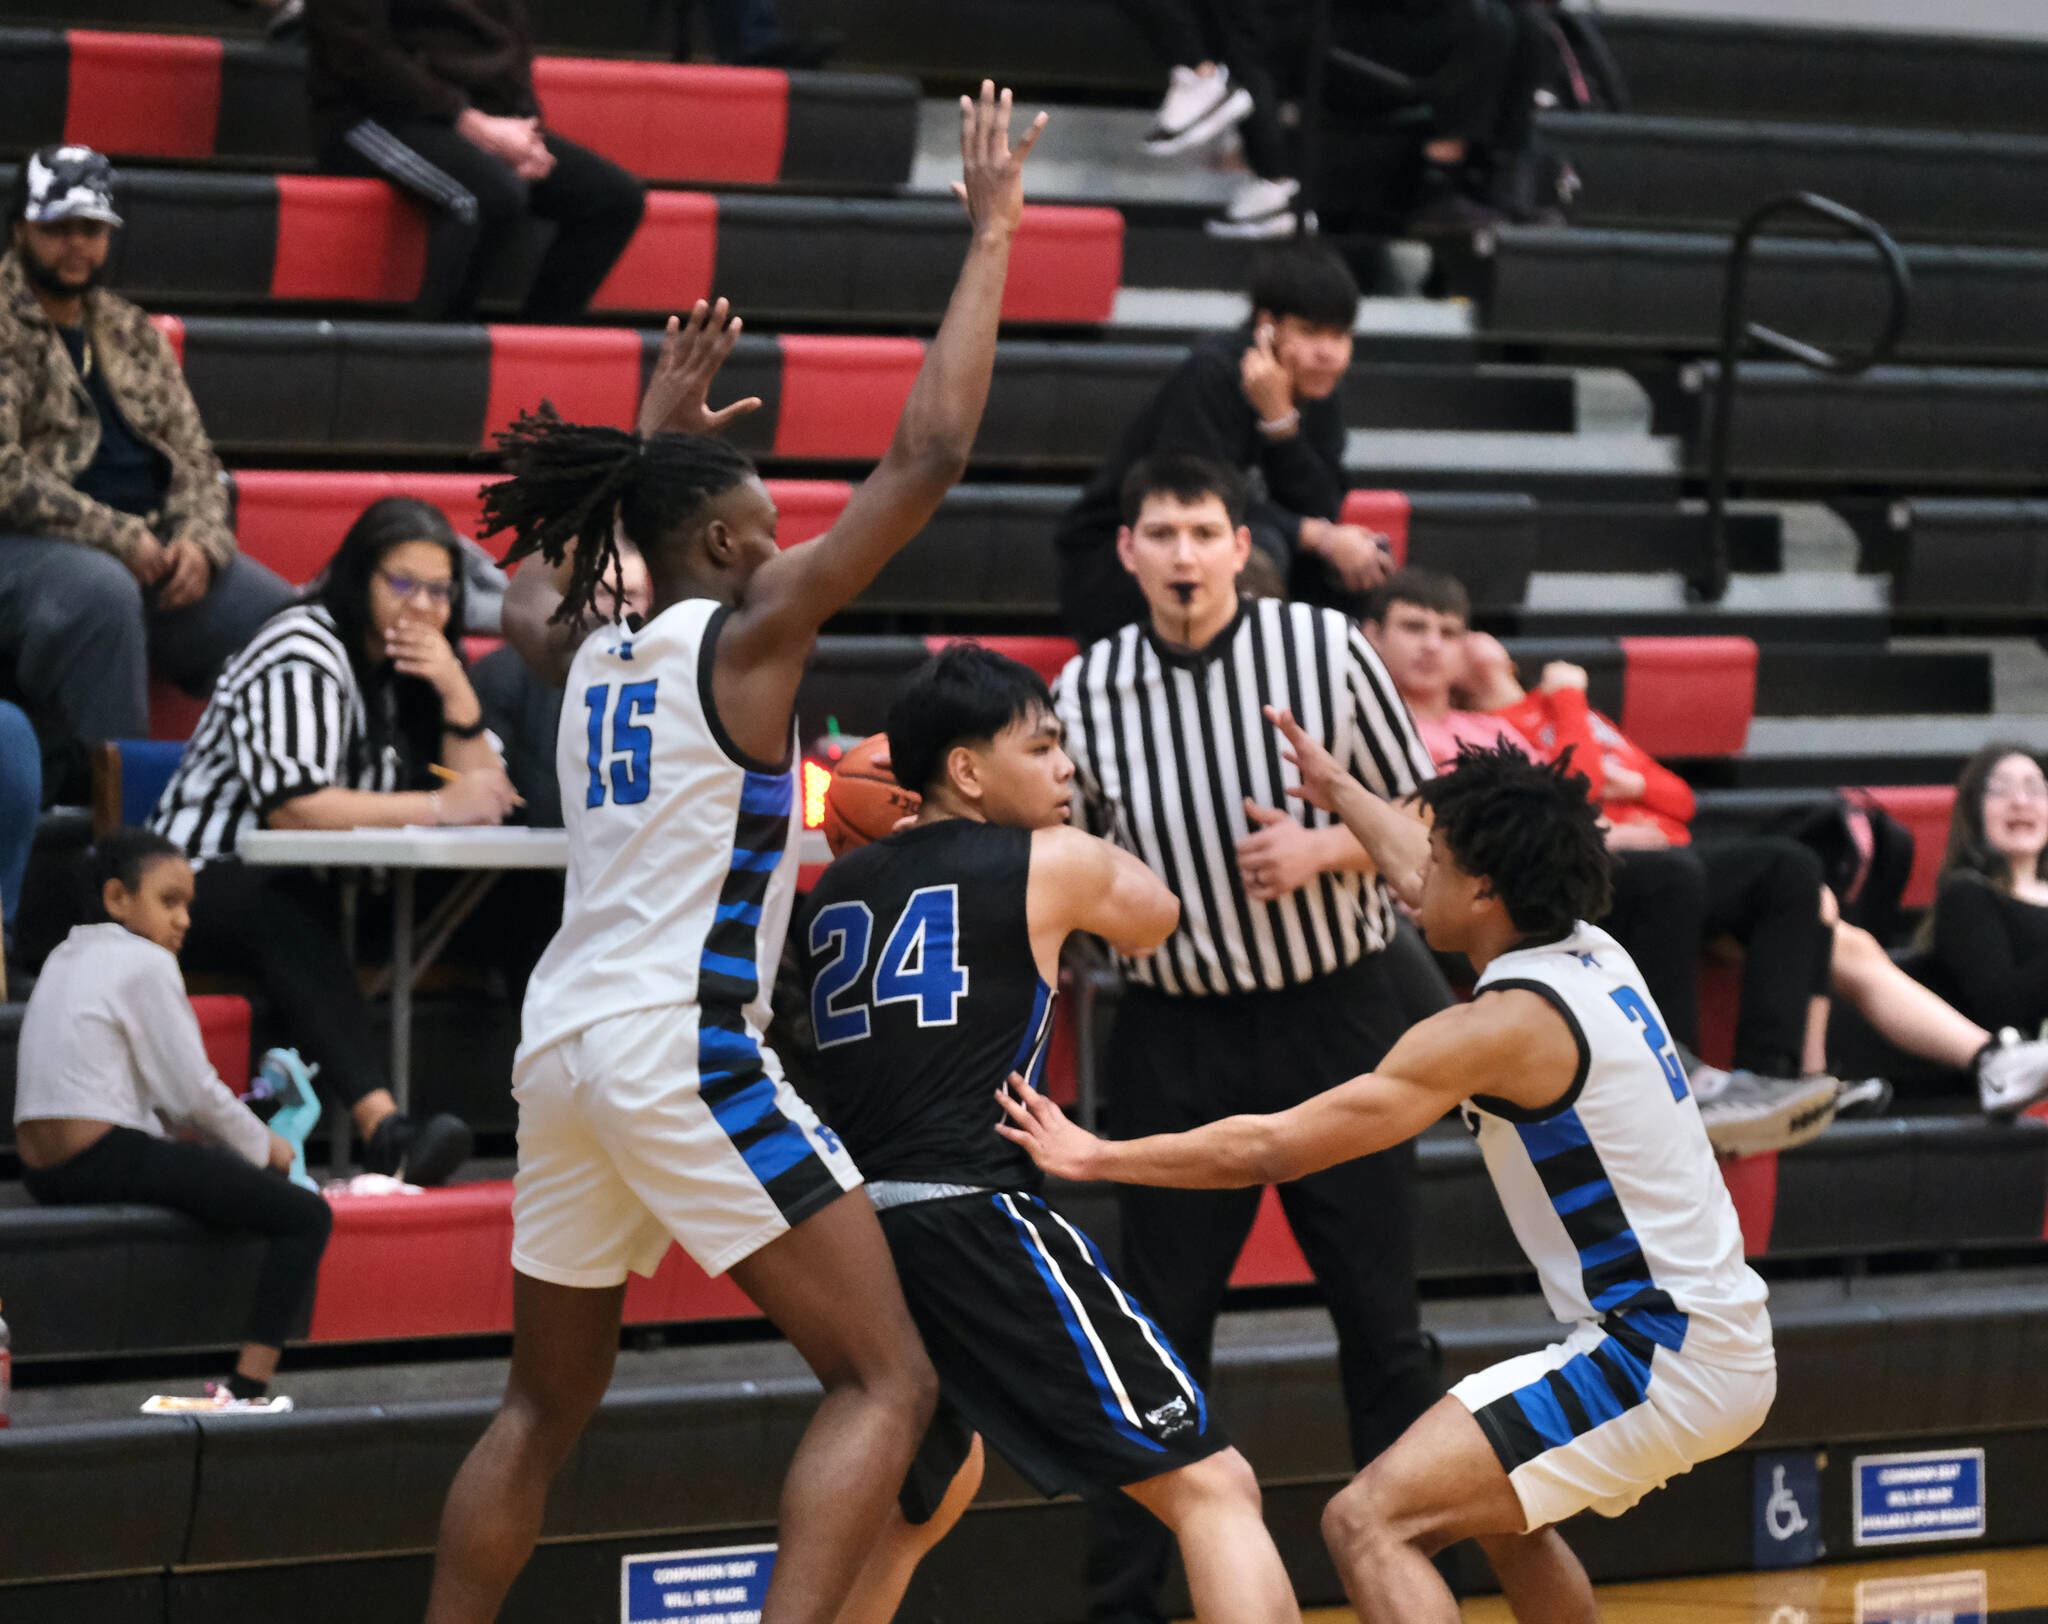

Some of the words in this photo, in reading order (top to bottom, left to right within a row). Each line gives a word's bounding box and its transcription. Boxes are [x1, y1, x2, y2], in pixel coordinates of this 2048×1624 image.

[585, 678, 658, 810] 15
[808, 883, 969, 1051] 24
[1608, 984, 1690, 1104] 2
